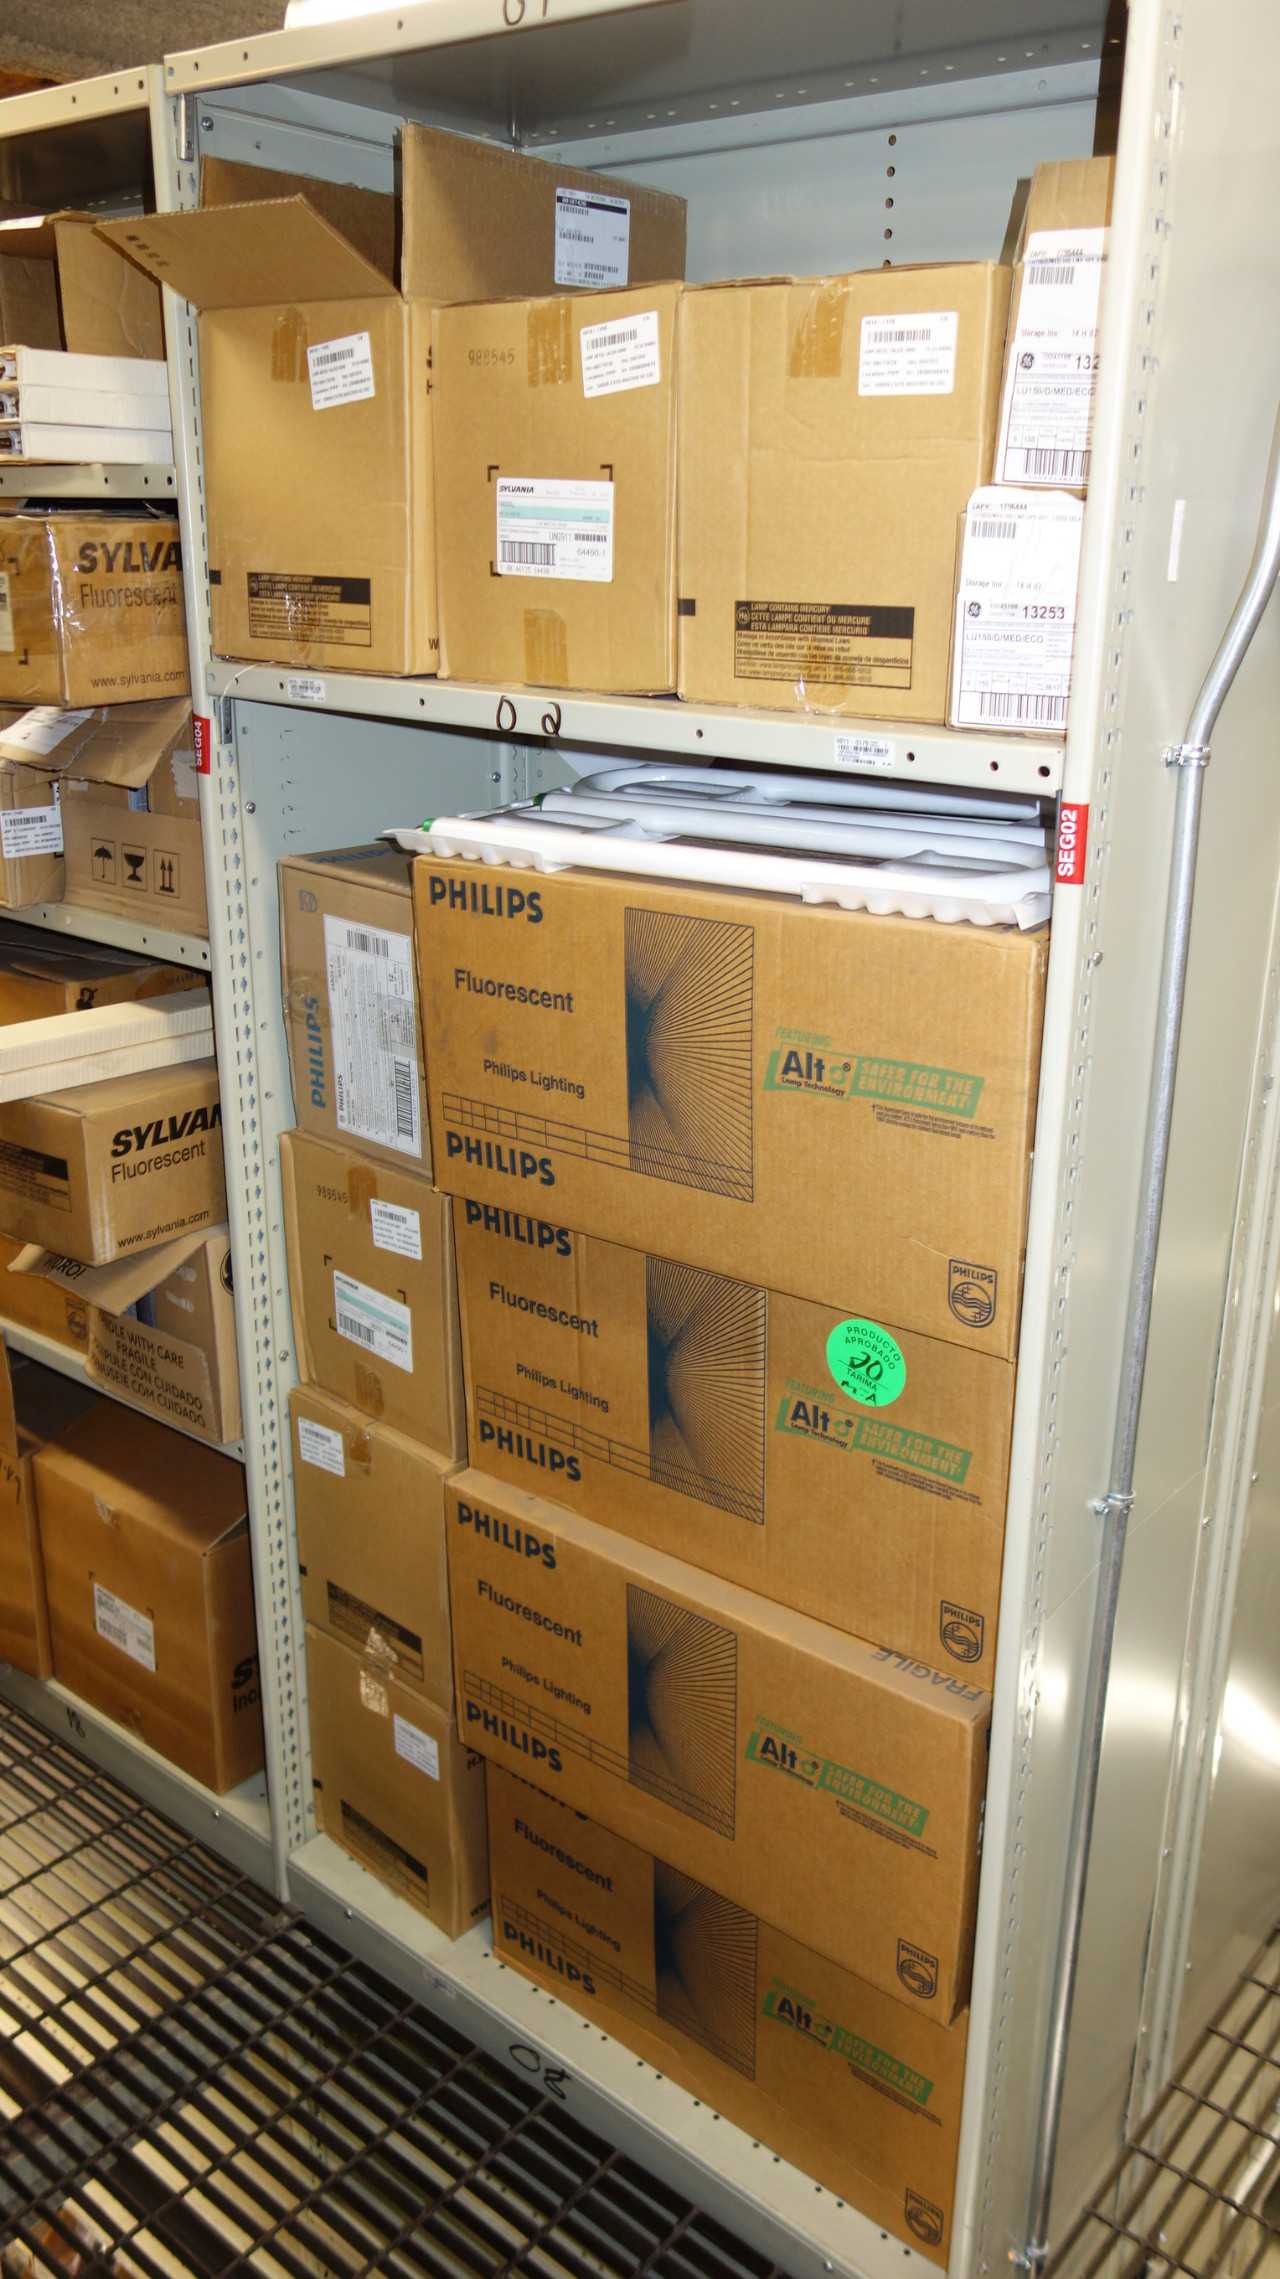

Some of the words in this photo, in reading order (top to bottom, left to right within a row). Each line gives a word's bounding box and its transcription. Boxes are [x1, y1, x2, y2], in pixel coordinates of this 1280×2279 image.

[498, 485, 535, 495] SYLVANIA
[79, 581, 178, 610] Fluorescent
[1023, 605, 1066, 620] 13253
[90, 669, 185, 689] www.sylvania.com
[1057, 809, 1078, 877] SEG02
[429, 876, 544, 923] PHILIPS
[454, 968, 574, 1013] Fluorescent
[305, 996, 326, 1109] PHILIPS
[483, 1058, 527, 1084] Philips
[530, 1069, 586, 1100] Lighting
[111, 1142, 207, 1184] Fluorescent
[447, 1131, 556, 1187] PHILIPS
[118, 1208, 210, 1249] www.sylvania.com
[466, 1200, 572, 1257] PHILIPS
[952, 1265, 995, 1285] PHILIPS
[489, 1281, 600, 1338] Fluorescent
[116, 1340, 158, 1373] FRAGILE
[127, 1331, 157, 1353] WITH
[157, 1344, 185, 1370] CARE
[845, 1336, 896, 1370] APROBADO
[846, 1326, 901, 1361] PRODUCTO
[516, 1363, 557, 1389] Philips
[559, 1377, 610, 1413] Lighting
[848, 1367, 877, 1393] TARIMA
[479, 1420, 581, 1482] PHILIPS
[457, 1501, 557, 1570] PHILIPS
[478, 1580, 584, 1647] Fluorescent
[943, 1605, 982, 1628] PHILIPS
[501, 1655, 541, 1686] Philips
[543, 1677, 593, 1716] Lighting
[871, 1647, 984, 1702] FRAGILE
[466, 1700, 563, 1773] PHILIPS
[514, 1818, 614, 1893] Fluorescent
[536, 1889, 574, 1921] Philips
[575, 1910, 622, 1953] Lighting
[503, 1920, 597, 1996] PHILIPS
[899, 1943, 938, 1969] PHILIPS
